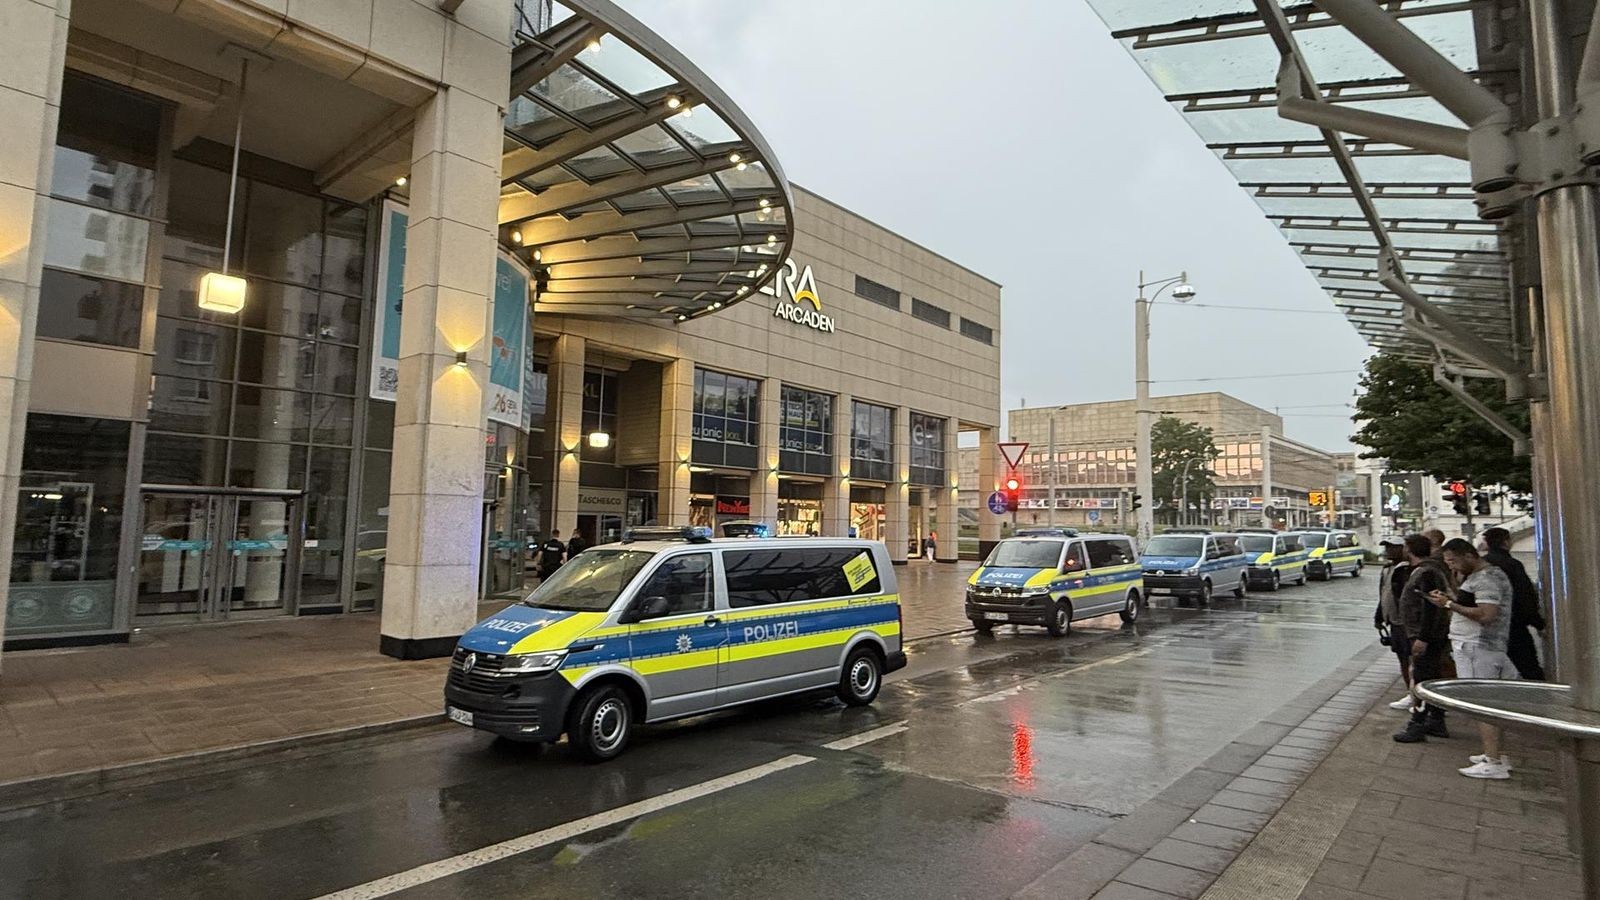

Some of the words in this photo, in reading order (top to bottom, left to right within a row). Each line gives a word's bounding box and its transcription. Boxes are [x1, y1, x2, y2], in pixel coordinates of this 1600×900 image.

[775, 301, 834, 333] ARCADEN
[482, 618, 529, 634] POLIZEI
[743, 621, 799, 642] POLIZEI
